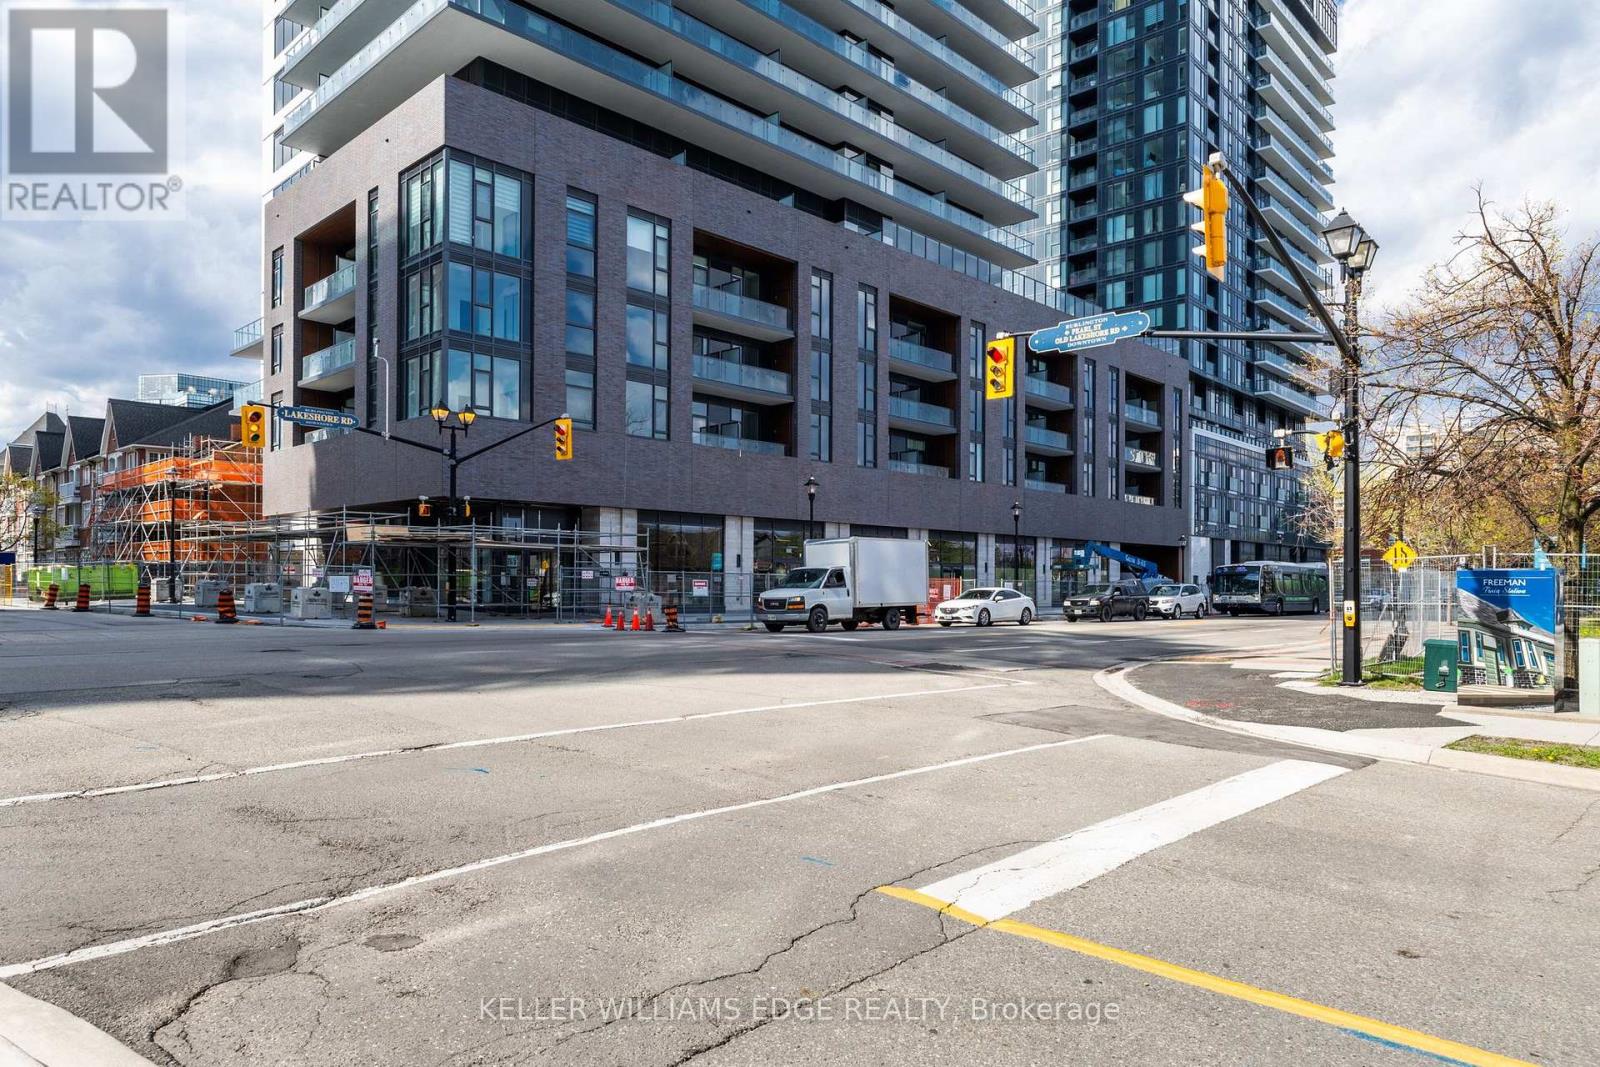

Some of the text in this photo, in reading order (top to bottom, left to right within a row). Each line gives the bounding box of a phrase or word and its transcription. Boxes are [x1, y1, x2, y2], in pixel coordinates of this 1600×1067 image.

[1065, 317, 1108, 329] BURLINGTON
[1071, 323, 1103, 335] PEARL ST
[1055, 327, 1120, 345] OLD LAKESHORE RD
[1067, 336, 1107, 348] DOWNTOWN
[284, 410, 339, 424] LAKESHORE
[340, 416, 353, 425] RD
